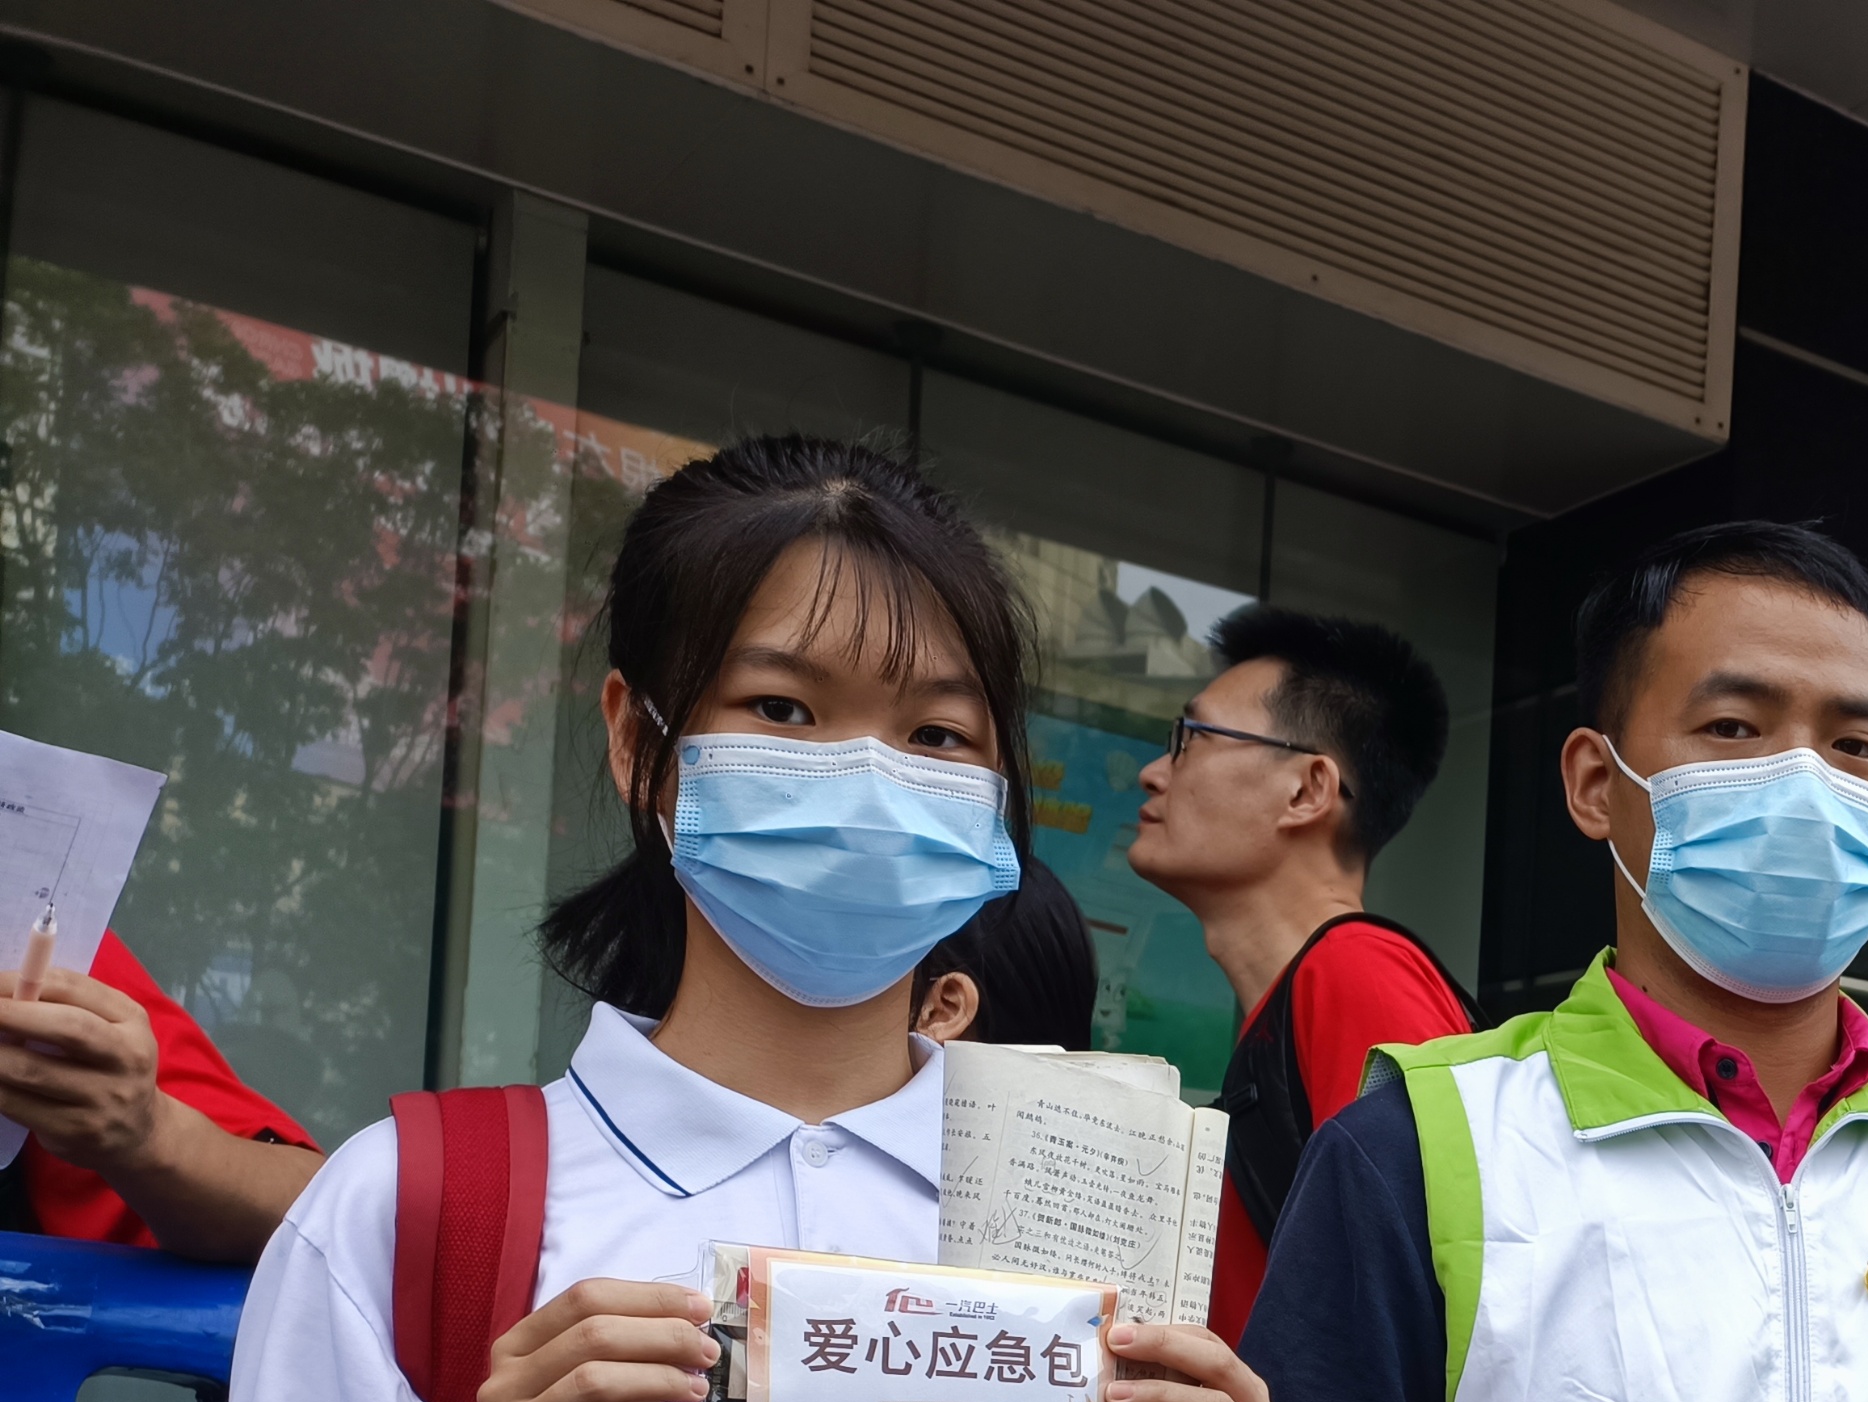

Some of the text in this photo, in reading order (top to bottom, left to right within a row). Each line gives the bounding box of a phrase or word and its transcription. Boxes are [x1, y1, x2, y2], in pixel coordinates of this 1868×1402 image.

[945, 1299, 999, 1316] 一汽巴士
[800, 1316, 1089, 1390] 爱心应急包
